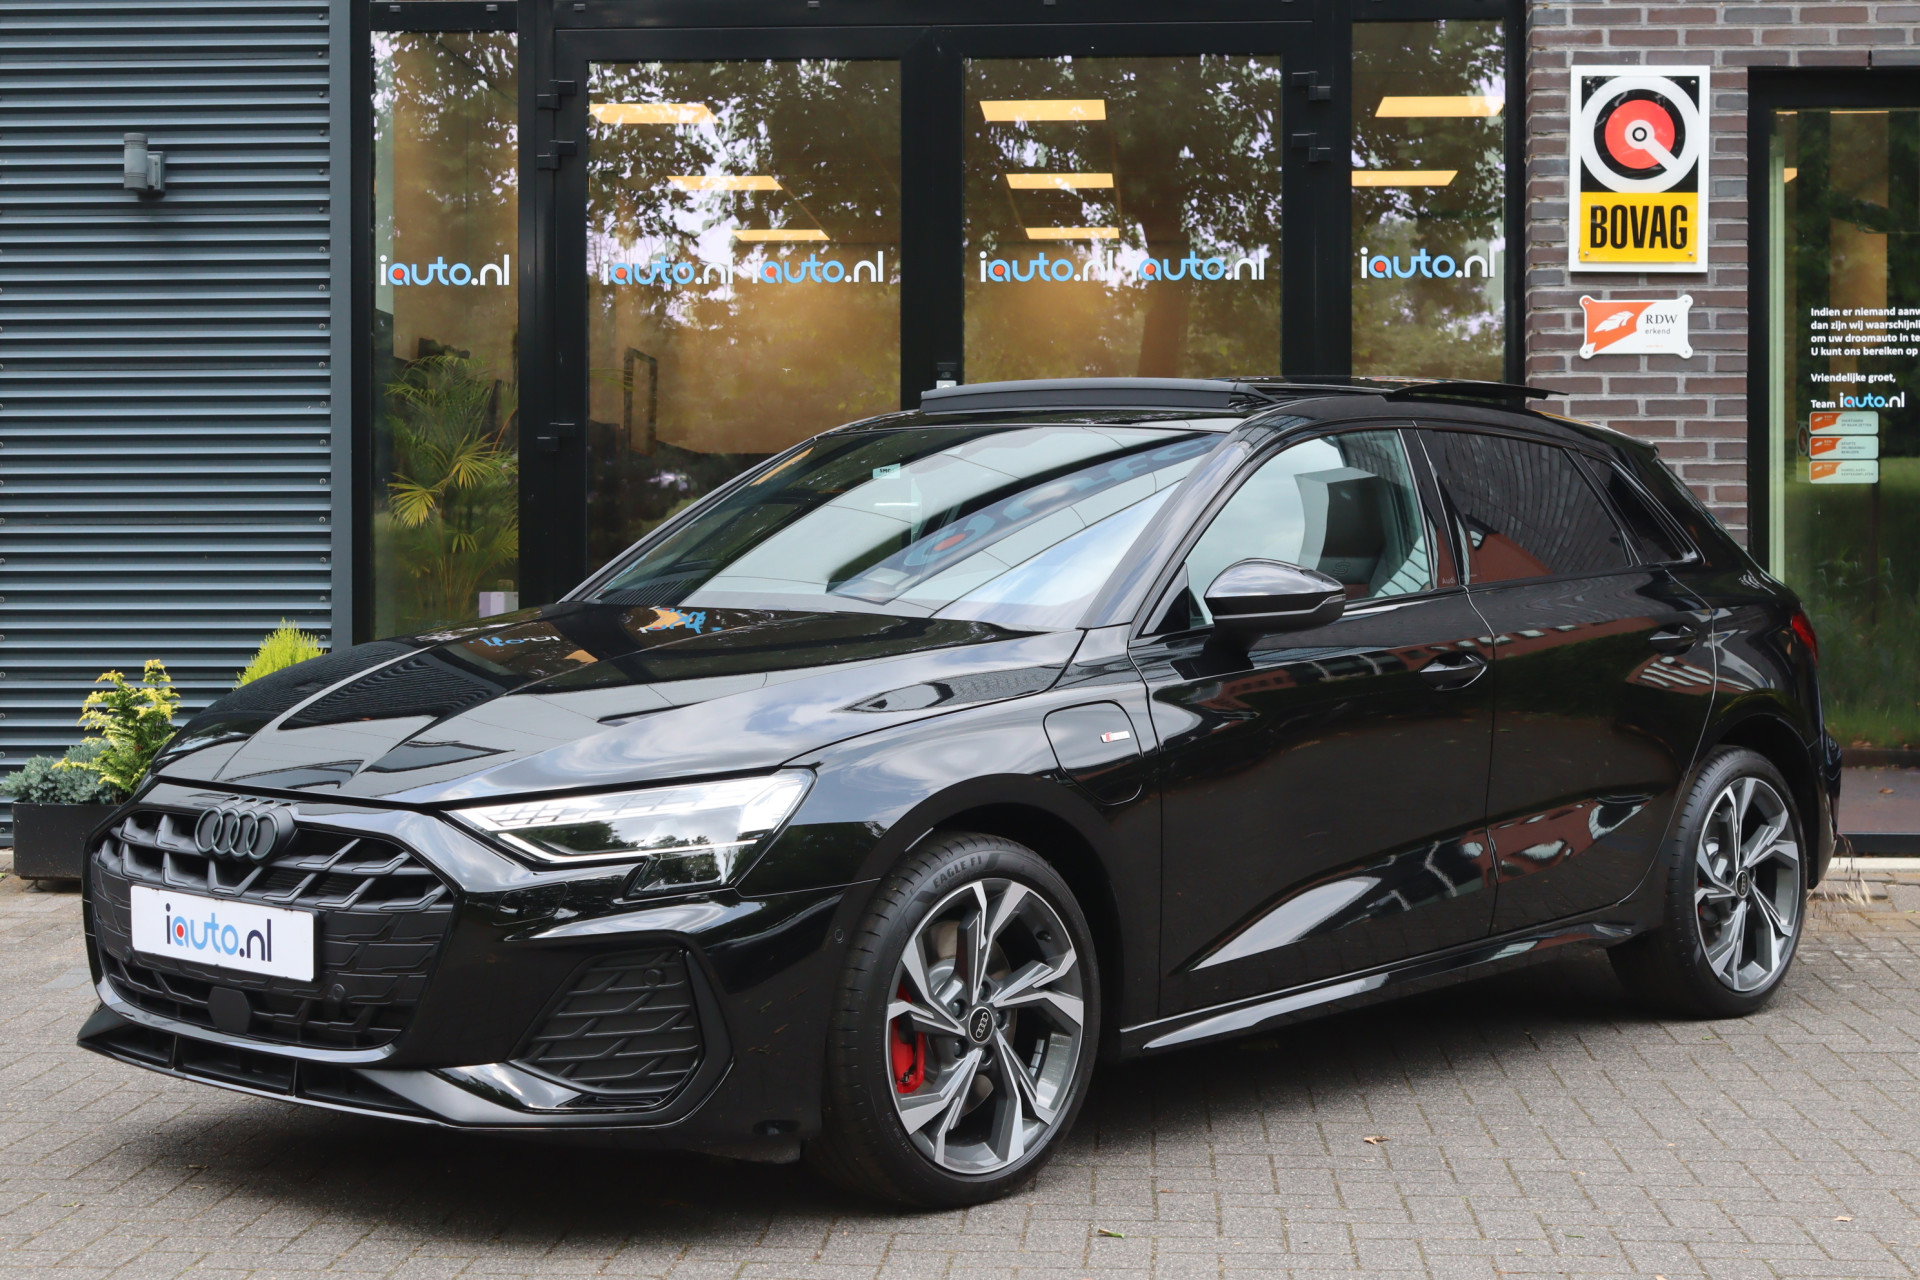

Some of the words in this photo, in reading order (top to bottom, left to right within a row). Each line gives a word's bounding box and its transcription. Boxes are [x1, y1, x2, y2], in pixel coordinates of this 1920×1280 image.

[1590, 205, 1688, 249] BOVAG
[379, 254, 510, 286] iauto.nl
[602, 254, 734, 286] iauto.nl
[751, 250, 884, 284] iauto.nl
[979, 250, 1113, 282] iauto.nl
[1130, 249, 1265, 281] iauto.nl
[1360, 247, 1495, 279] iauto.nl
[1645, 314, 1678, 324] RDW
[1810, 307, 1840, 317] Indien
[1842, 309, 1853, 317] er
[1854, 307, 1896, 317] niemand
[1810, 320, 1829, 330] dan
[1830, 320, 1847, 332] zijn
[1849, 320, 1864, 331] wij
[1810, 335, 1827, 343] om
[1828, 335, 1844, 343] uw
[1845, 333, 1898, 343] droomauto
[1900, 333, 1909, 342] in
[1810, 347, 1819, 356] U
[1820, 346, 1842, 356] kunt
[1843, 348, 1861, 356] ons
[1863, 346, 1904, 356] bereiken
[1905, 347, 1919, 357] op
[1810, 373, 1867, 384] Vriendelijke
[1868, 373, 1897, 384] groet,
[1810, 400, 1836, 409] Team
[1839, 392, 1906, 408] iauto.nl
[933, 860, 968, 889] EAGLE
[165, 903, 272, 962] iauto.nl
